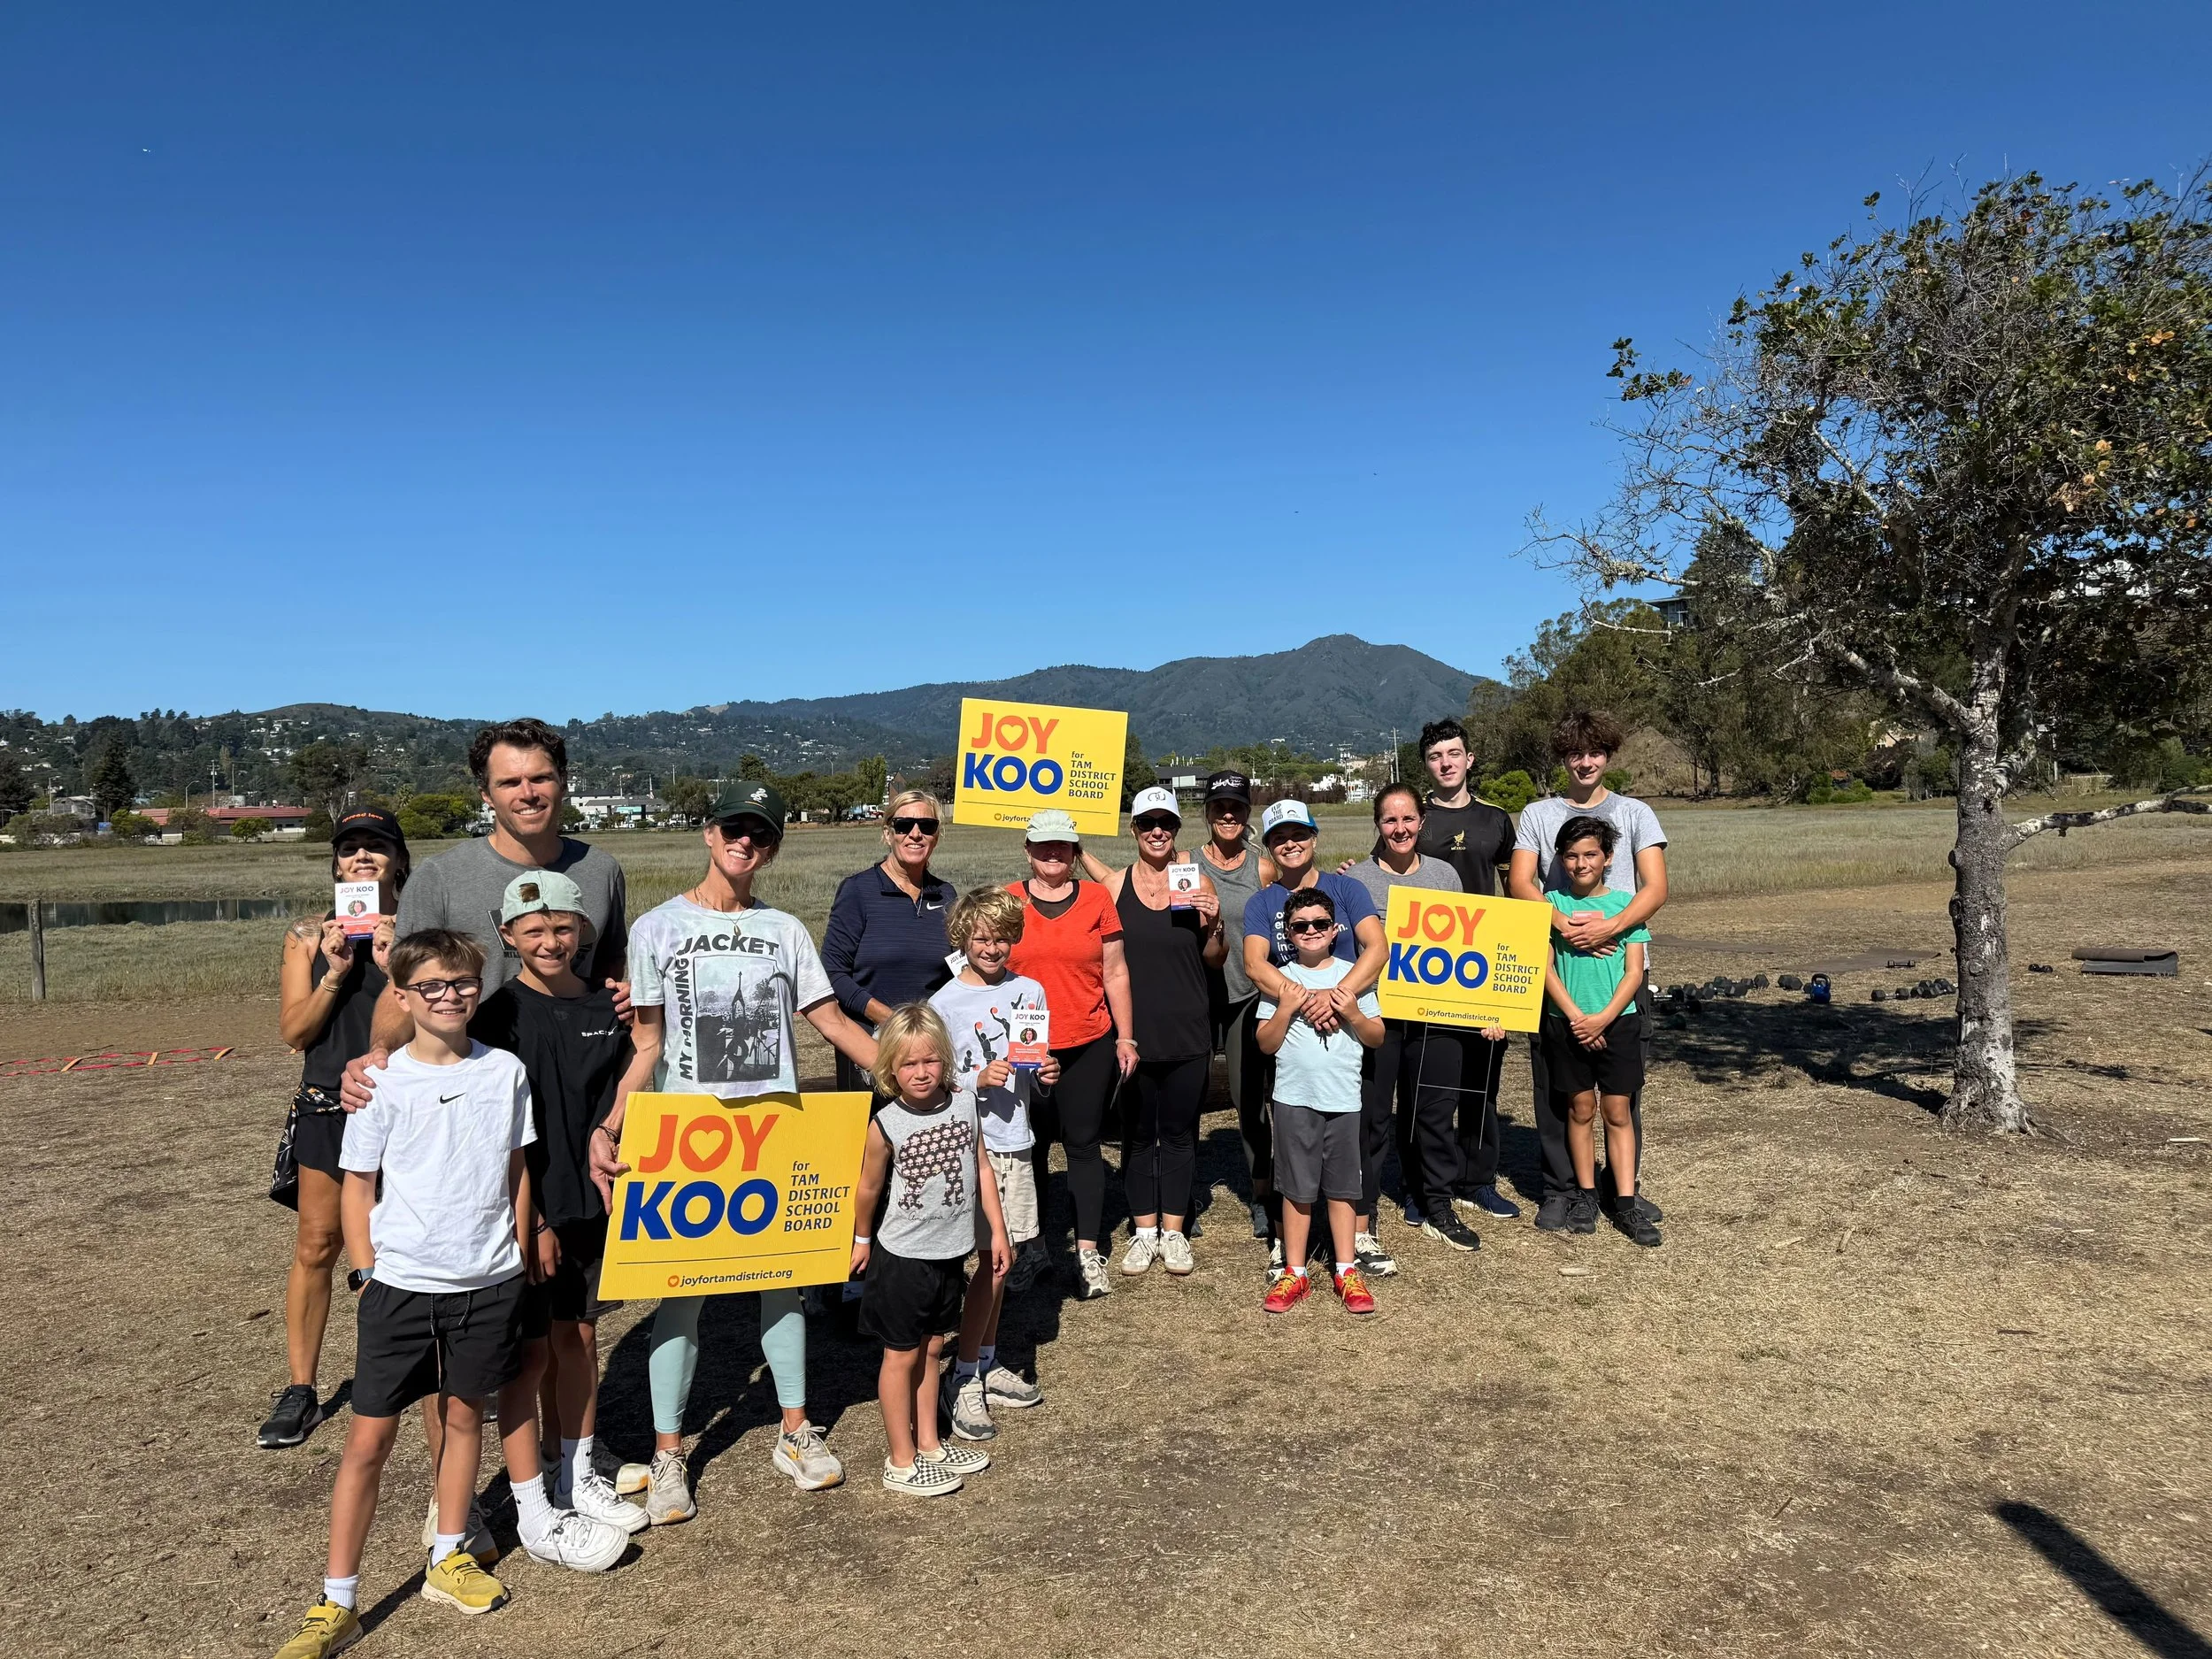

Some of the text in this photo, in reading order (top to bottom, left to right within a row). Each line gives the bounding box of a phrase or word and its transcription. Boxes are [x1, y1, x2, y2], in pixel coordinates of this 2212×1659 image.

[971, 712, 1059, 754] JOY
[1071, 750, 1085, 759] for
[1071, 760, 1093, 770] TAM
[963, 752, 1064, 795] KOO
[1070, 770, 1117, 781] DISTRICT
[1068, 779, 1110, 790] SCHOOL
[1068, 788, 1104, 800] BOARD
[1397, 901, 1486, 946] JOY
[676, 933, 780, 956] JACKET
[1387, 942, 1489, 989] KOO
[1496, 953, 1517, 963] TAM
[1495, 963, 1540, 976] DISTRICT
[1494, 973, 1533, 985] SCHOOL
[1493, 983, 1527, 995] BOARD
[1425, 1009, 1500, 1024] joyfortamdistrict.org
[637, 1114, 780, 1173] JOY
[792, 1160, 810, 1172] for
[791, 1173, 819, 1187] TAM
[788, 1186, 850, 1202] DISTRICT
[619, 1179, 779, 1241] KOO
[786, 1202, 841, 1217] SCHOOL
[784, 1217, 833, 1233] BOARD
[680, 1268, 793, 1288] joyfortamdistrict.org
